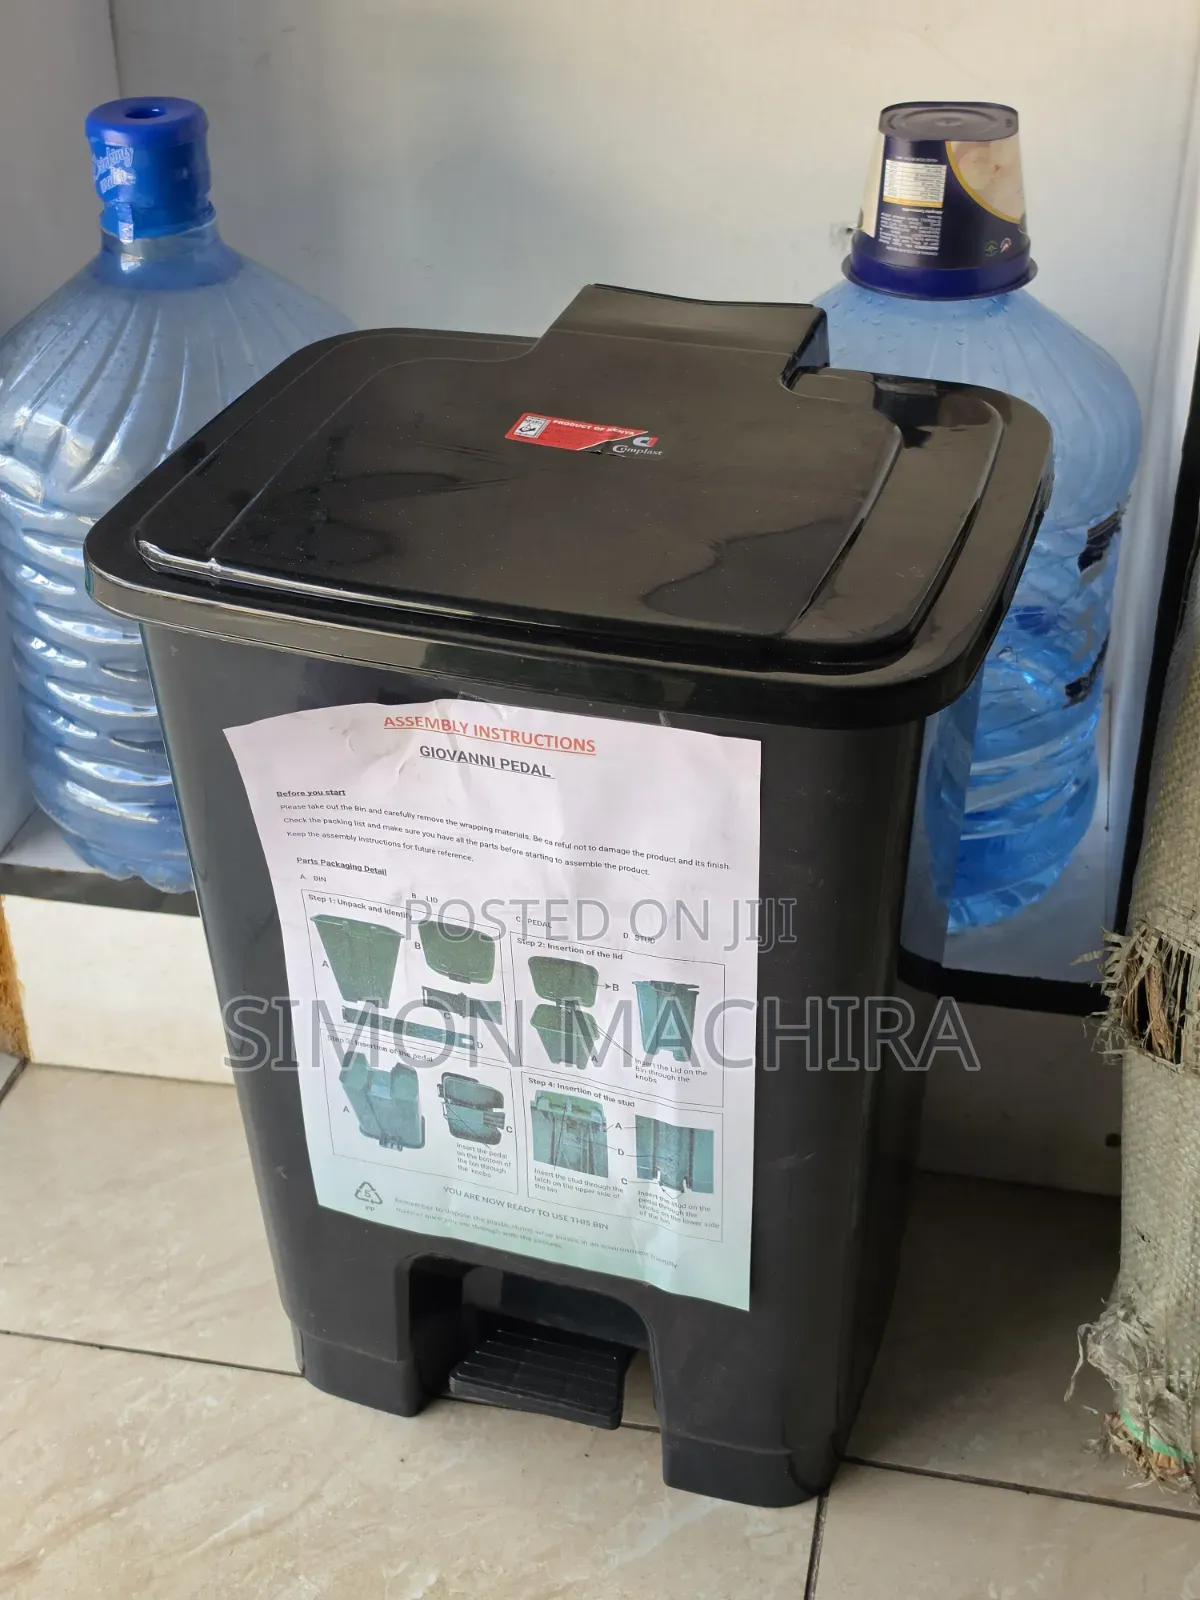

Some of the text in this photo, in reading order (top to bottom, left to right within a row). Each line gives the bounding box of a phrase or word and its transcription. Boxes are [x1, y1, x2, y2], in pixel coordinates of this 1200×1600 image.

[553, 420, 592, 430] PRODUCT
[612, 445, 662, 456] Complast
[384, 717, 596, 752] ASSEMBLY INSTRUCTIONS
[420, 745, 551, 778] GIOVANNI PEDAL
[322, 833, 356, 841] assembly
[359, 836, 401, 848] instructions
[403, 842, 413, 851] for
[415, 845, 435, 854] future
[438, 850, 474, 861] reference.
[323, 818, 352, 826] packing
[383, 823, 403, 832] make
[405, 827, 420, 835] sure
[422, 831, 435, 839] you
[437, 833, 454, 841] have
[480, 841, 498, 851] parts
[501, 844, 523, 855] before
[525, 850, 553, 862] starting
[565, 859, 602, 868] assemble
[618, 865, 649, 875] product.
[369, 807, 382, 815] and
[384, 809, 415, 820] carefully
[417, 814, 444, 824] remove
[446, 816, 457, 827] the
[460, 822, 493, 834] wrapping
[495, 827, 530, 840] materials.
[533, 835, 542, 844] Be
[555, 840, 571, 850] reful
[574, 843, 586, 851] not
[589, 844, 596, 852] to
[599, 845, 630, 857] damage
[632, 849, 645, 858] the
[646, 852, 676, 865] product
[679, 856, 692, 865] and
[695, 859, 705, 867] its
[707, 862, 731, 870] finish.
[297, 857, 387, 874] Parts Packaging Detail
[308, 894, 326, 904] Step
[337, 900, 366, 910] Unpack
[368, 904, 382, 913] and
[384, 907, 412, 920] identify
[528, 918, 552, 928] PEDAL
[517, 938, 536, 948] Step
[547, 943, 584, 955] Insertion
[635, 935, 655, 944] STUD
[328, 1035, 345, 1044] Step
[355, 1040, 387, 1053] Insertion
[399, 1049, 411, 1057] the
[413, 1053, 433, 1063] pedal
[649, 1068, 676, 1081] through
[670, 1066, 682, 1074] Lid
[635, 1074, 657, 1084] knobs
[528, 1078, 546, 1086] Step
[557, 1083, 591, 1095] Insertion
[603, 1095, 616, 1103] the
[618, 1099, 634, 1107] stud
[457, 1143, 507, 1159] Insert the pedal
[478, 1155, 502, 1165] bottom
[481, 1162, 506, 1174] through
[472, 1168, 491, 1178] knobs
[534, 1168, 553, 1178] Insert
[555, 1173, 566, 1181] the
[584, 1178, 610, 1191] through
[365, 1190, 370, 1198] 5
[534, 1176, 551, 1185] latch
[576, 1187, 595, 1196] upper
[444, 1186, 461, 1196] YOU
[464, 1192, 480, 1201] ARE
[483, 1197, 505, 1208] NOW
[507, 1202, 535, 1214] READY
[552, 1213, 568, 1221] USE
[571, 1217, 590, 1226] THIS
[593, 1222, 608, 1230] BIN
